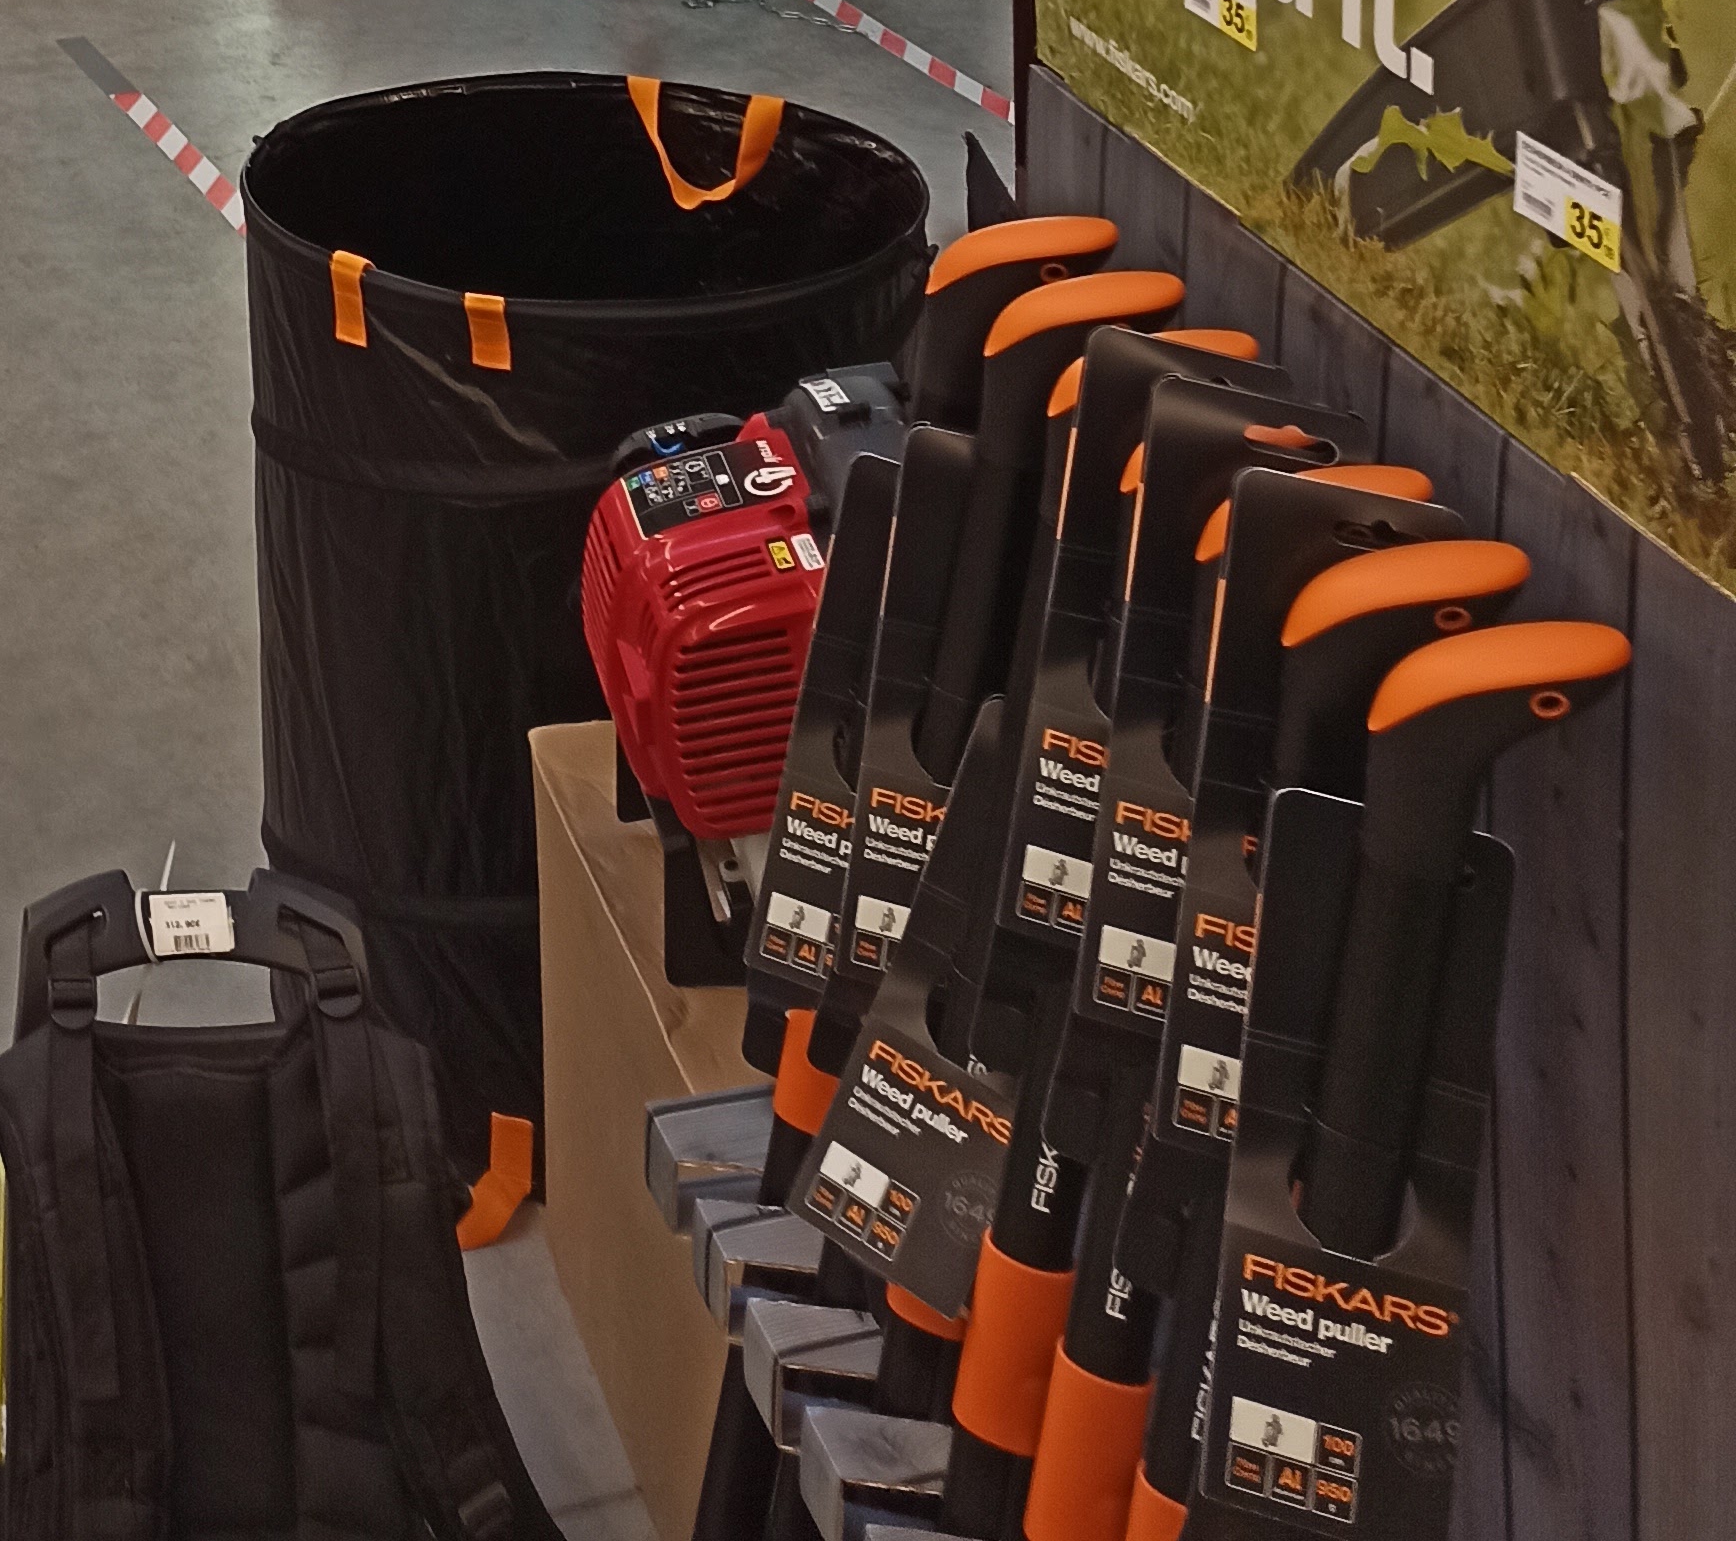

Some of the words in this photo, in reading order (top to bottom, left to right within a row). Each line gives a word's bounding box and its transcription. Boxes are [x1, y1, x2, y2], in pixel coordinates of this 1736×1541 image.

[1039, 757, 1100, 792] Weed
[787, 815, 839, 850] Weed
[869, 813, 923, 845] Weed
[1112, 831, 1178, 868] Weed
[862, 1063, 914, 1111] Weed
[911, 1103, 969, 1145] puller
[869, 1039, 1014, 1147] FISKARS
[1240, 1287, 1314, 1331] Weed
[1317, 1316, 1394, 1355] puller
[1243, 1253, 1451, 1339] FISKARS
